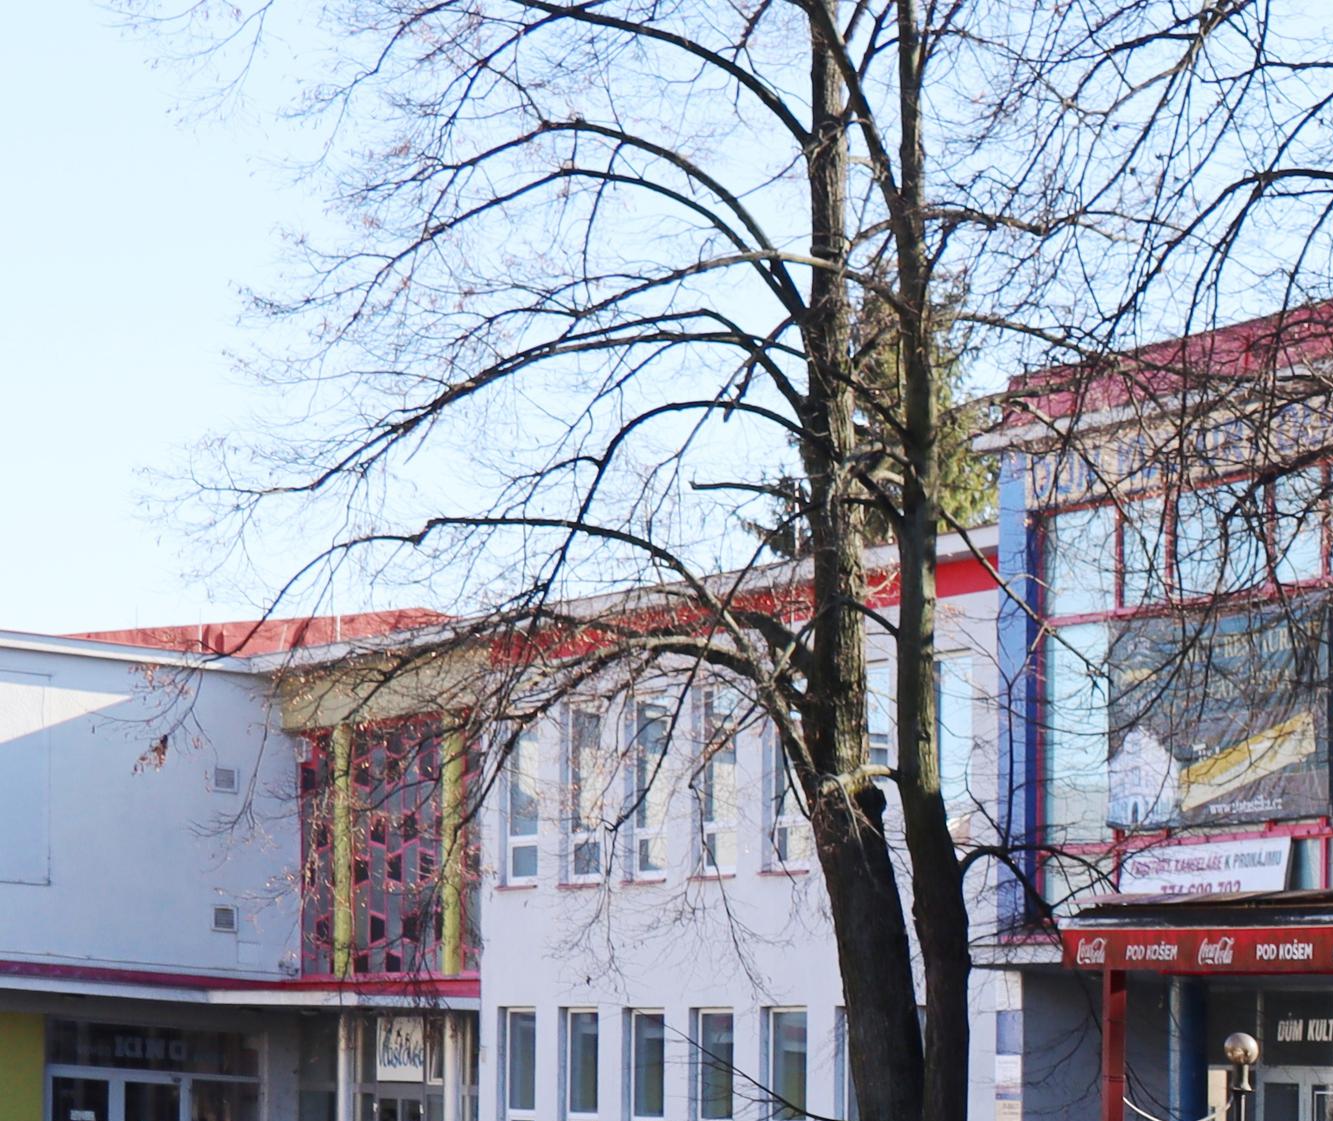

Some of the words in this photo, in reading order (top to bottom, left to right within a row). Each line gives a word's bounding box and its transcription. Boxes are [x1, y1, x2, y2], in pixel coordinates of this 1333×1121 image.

[1225, 855, 1231, 869] K
[1233, 849, 1282, 867] PRONÁJMU
[1126, 944, 1145, 960] POD
[1147, 941, 1178, 960] KOŠEM
[1256, 944, 1277, 960] POD
[1279, 939, 1312, 960] KOŠEM
[1277, 1012, 1303, 1041] DŮM
[114, 1035, 188, 1060] KINO
